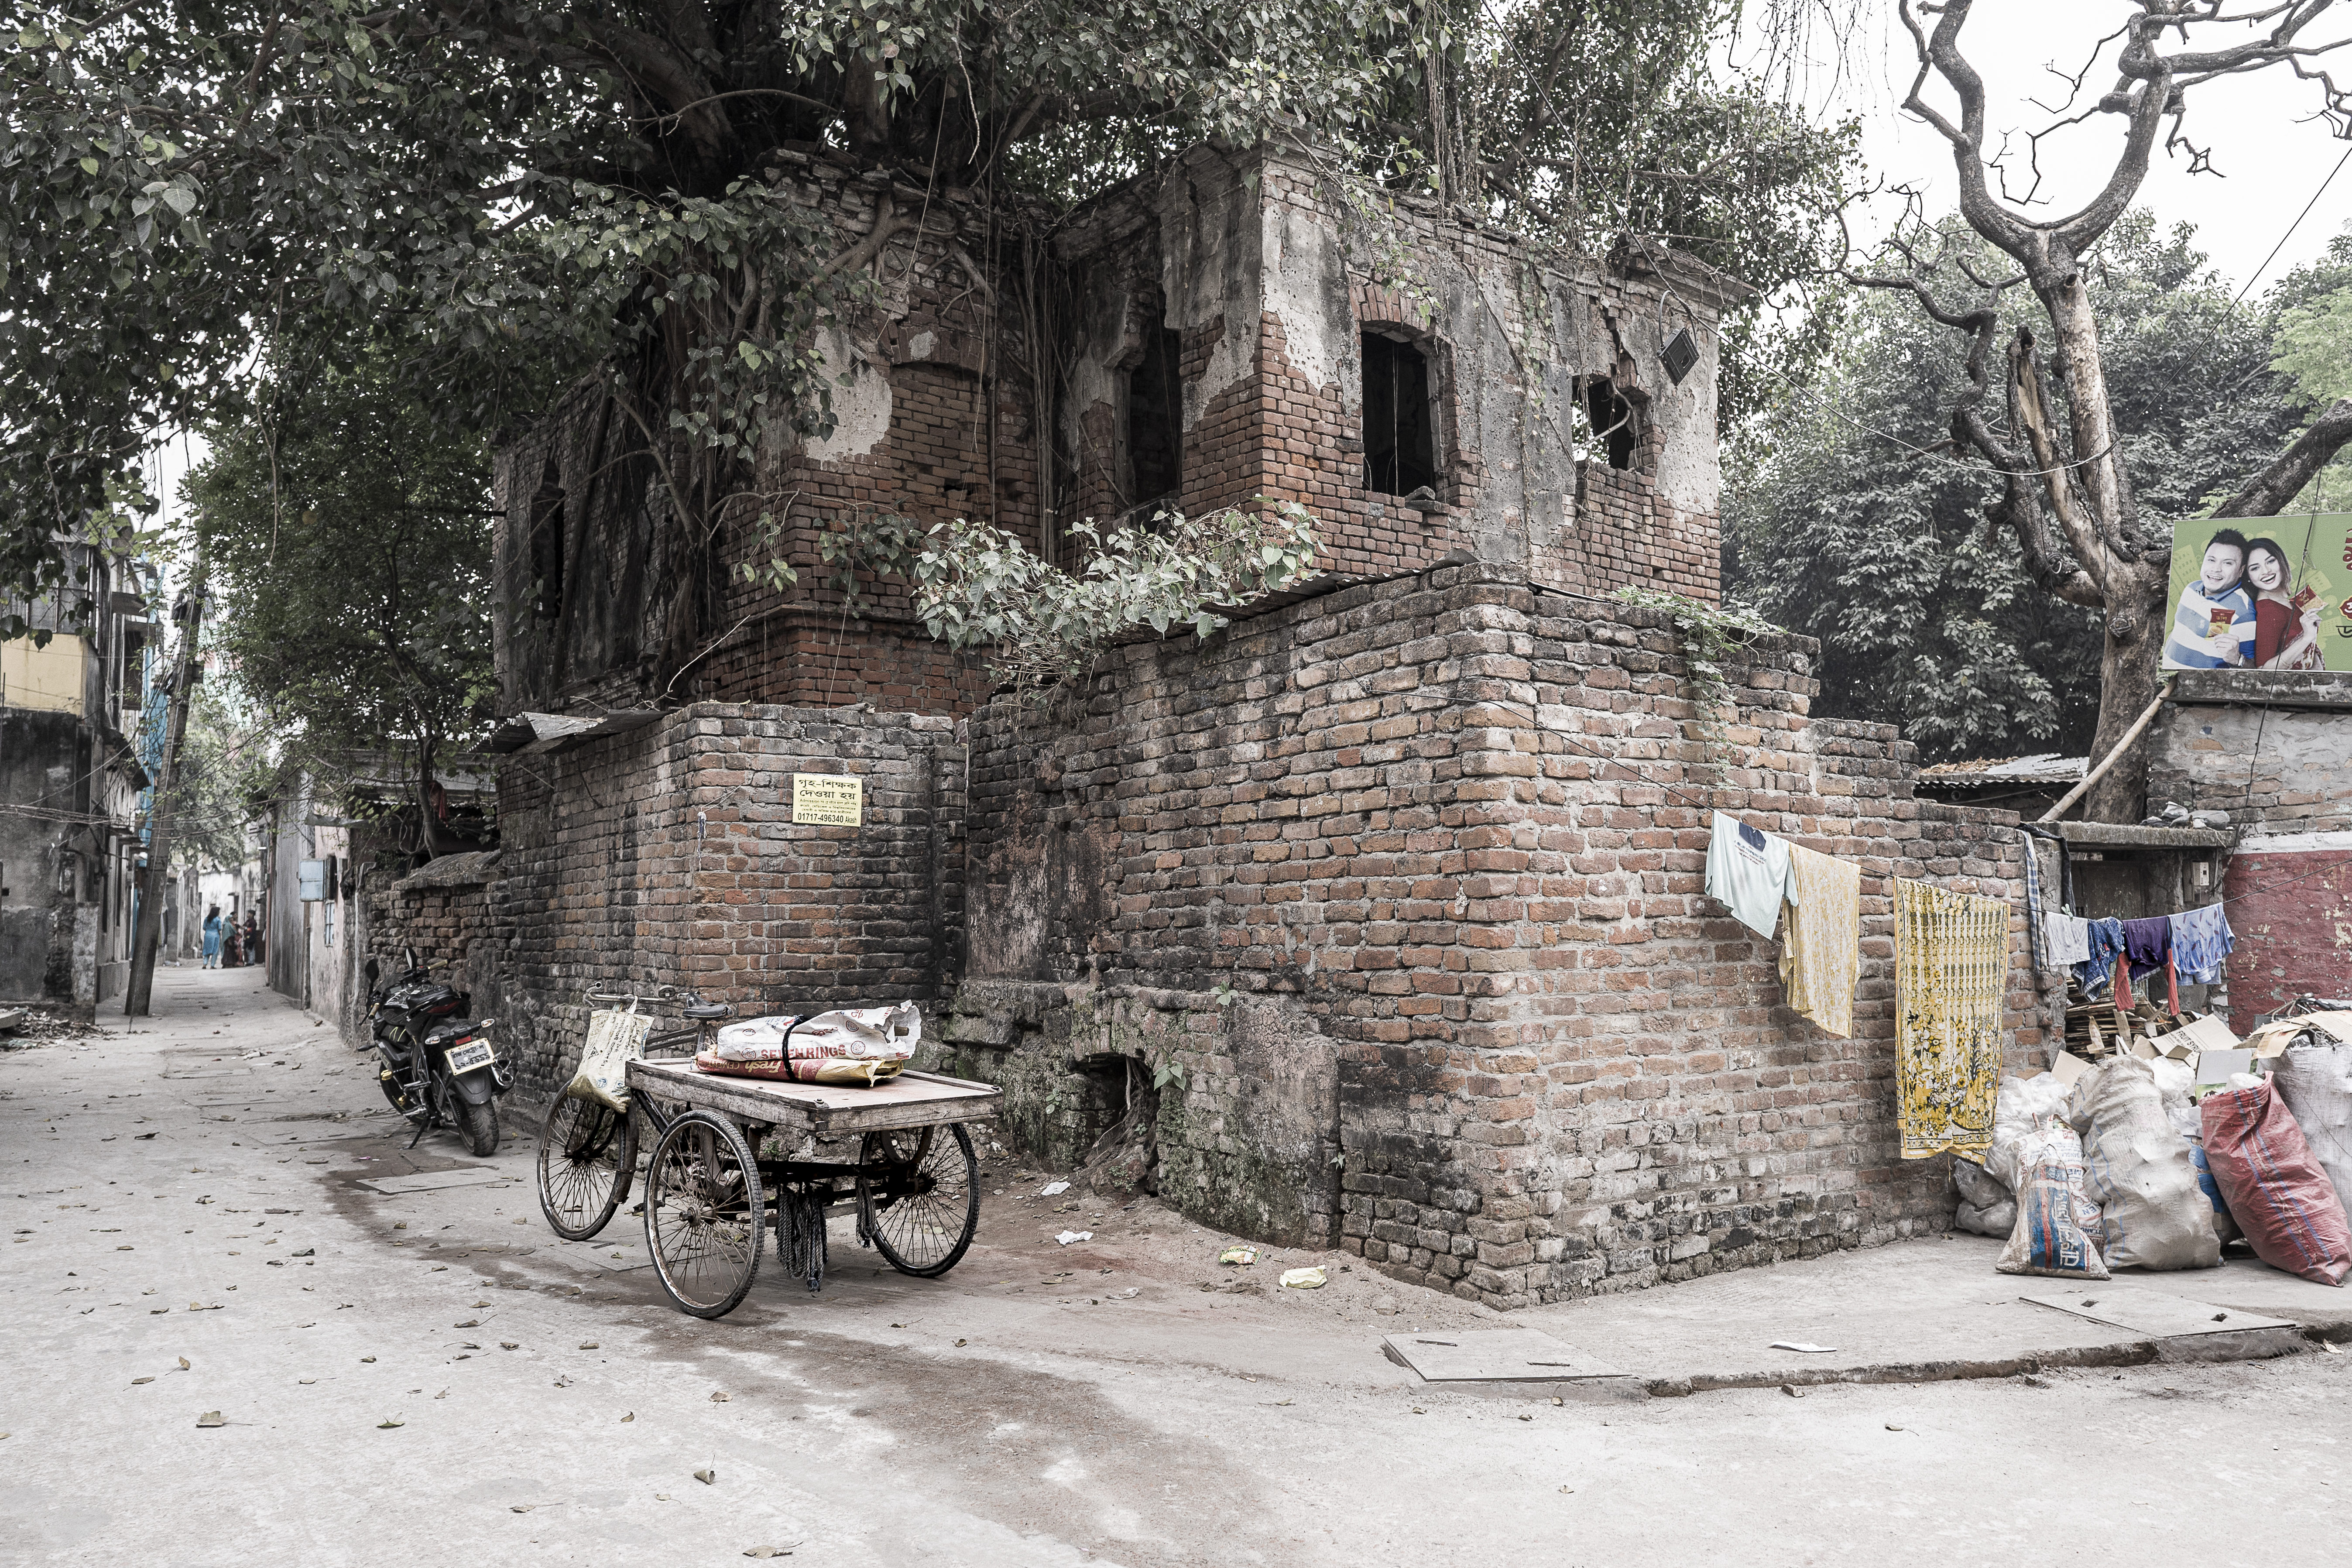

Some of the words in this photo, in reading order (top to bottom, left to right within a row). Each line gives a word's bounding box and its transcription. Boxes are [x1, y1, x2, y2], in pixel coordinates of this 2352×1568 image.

[799, 779, 857, 789] গৃহ-শিক্ষক
[800, 790, 836, 798] দেওয়া
[798, 813, 843, 823] 01717-496340
[2178, 1030, 2191, 1042] FRUIT
[806, 1044, 846, 1059] RINGS
[707, 1060, 740, 1069] CEMENT
[745, 1060, 782, 1073] Fresh
